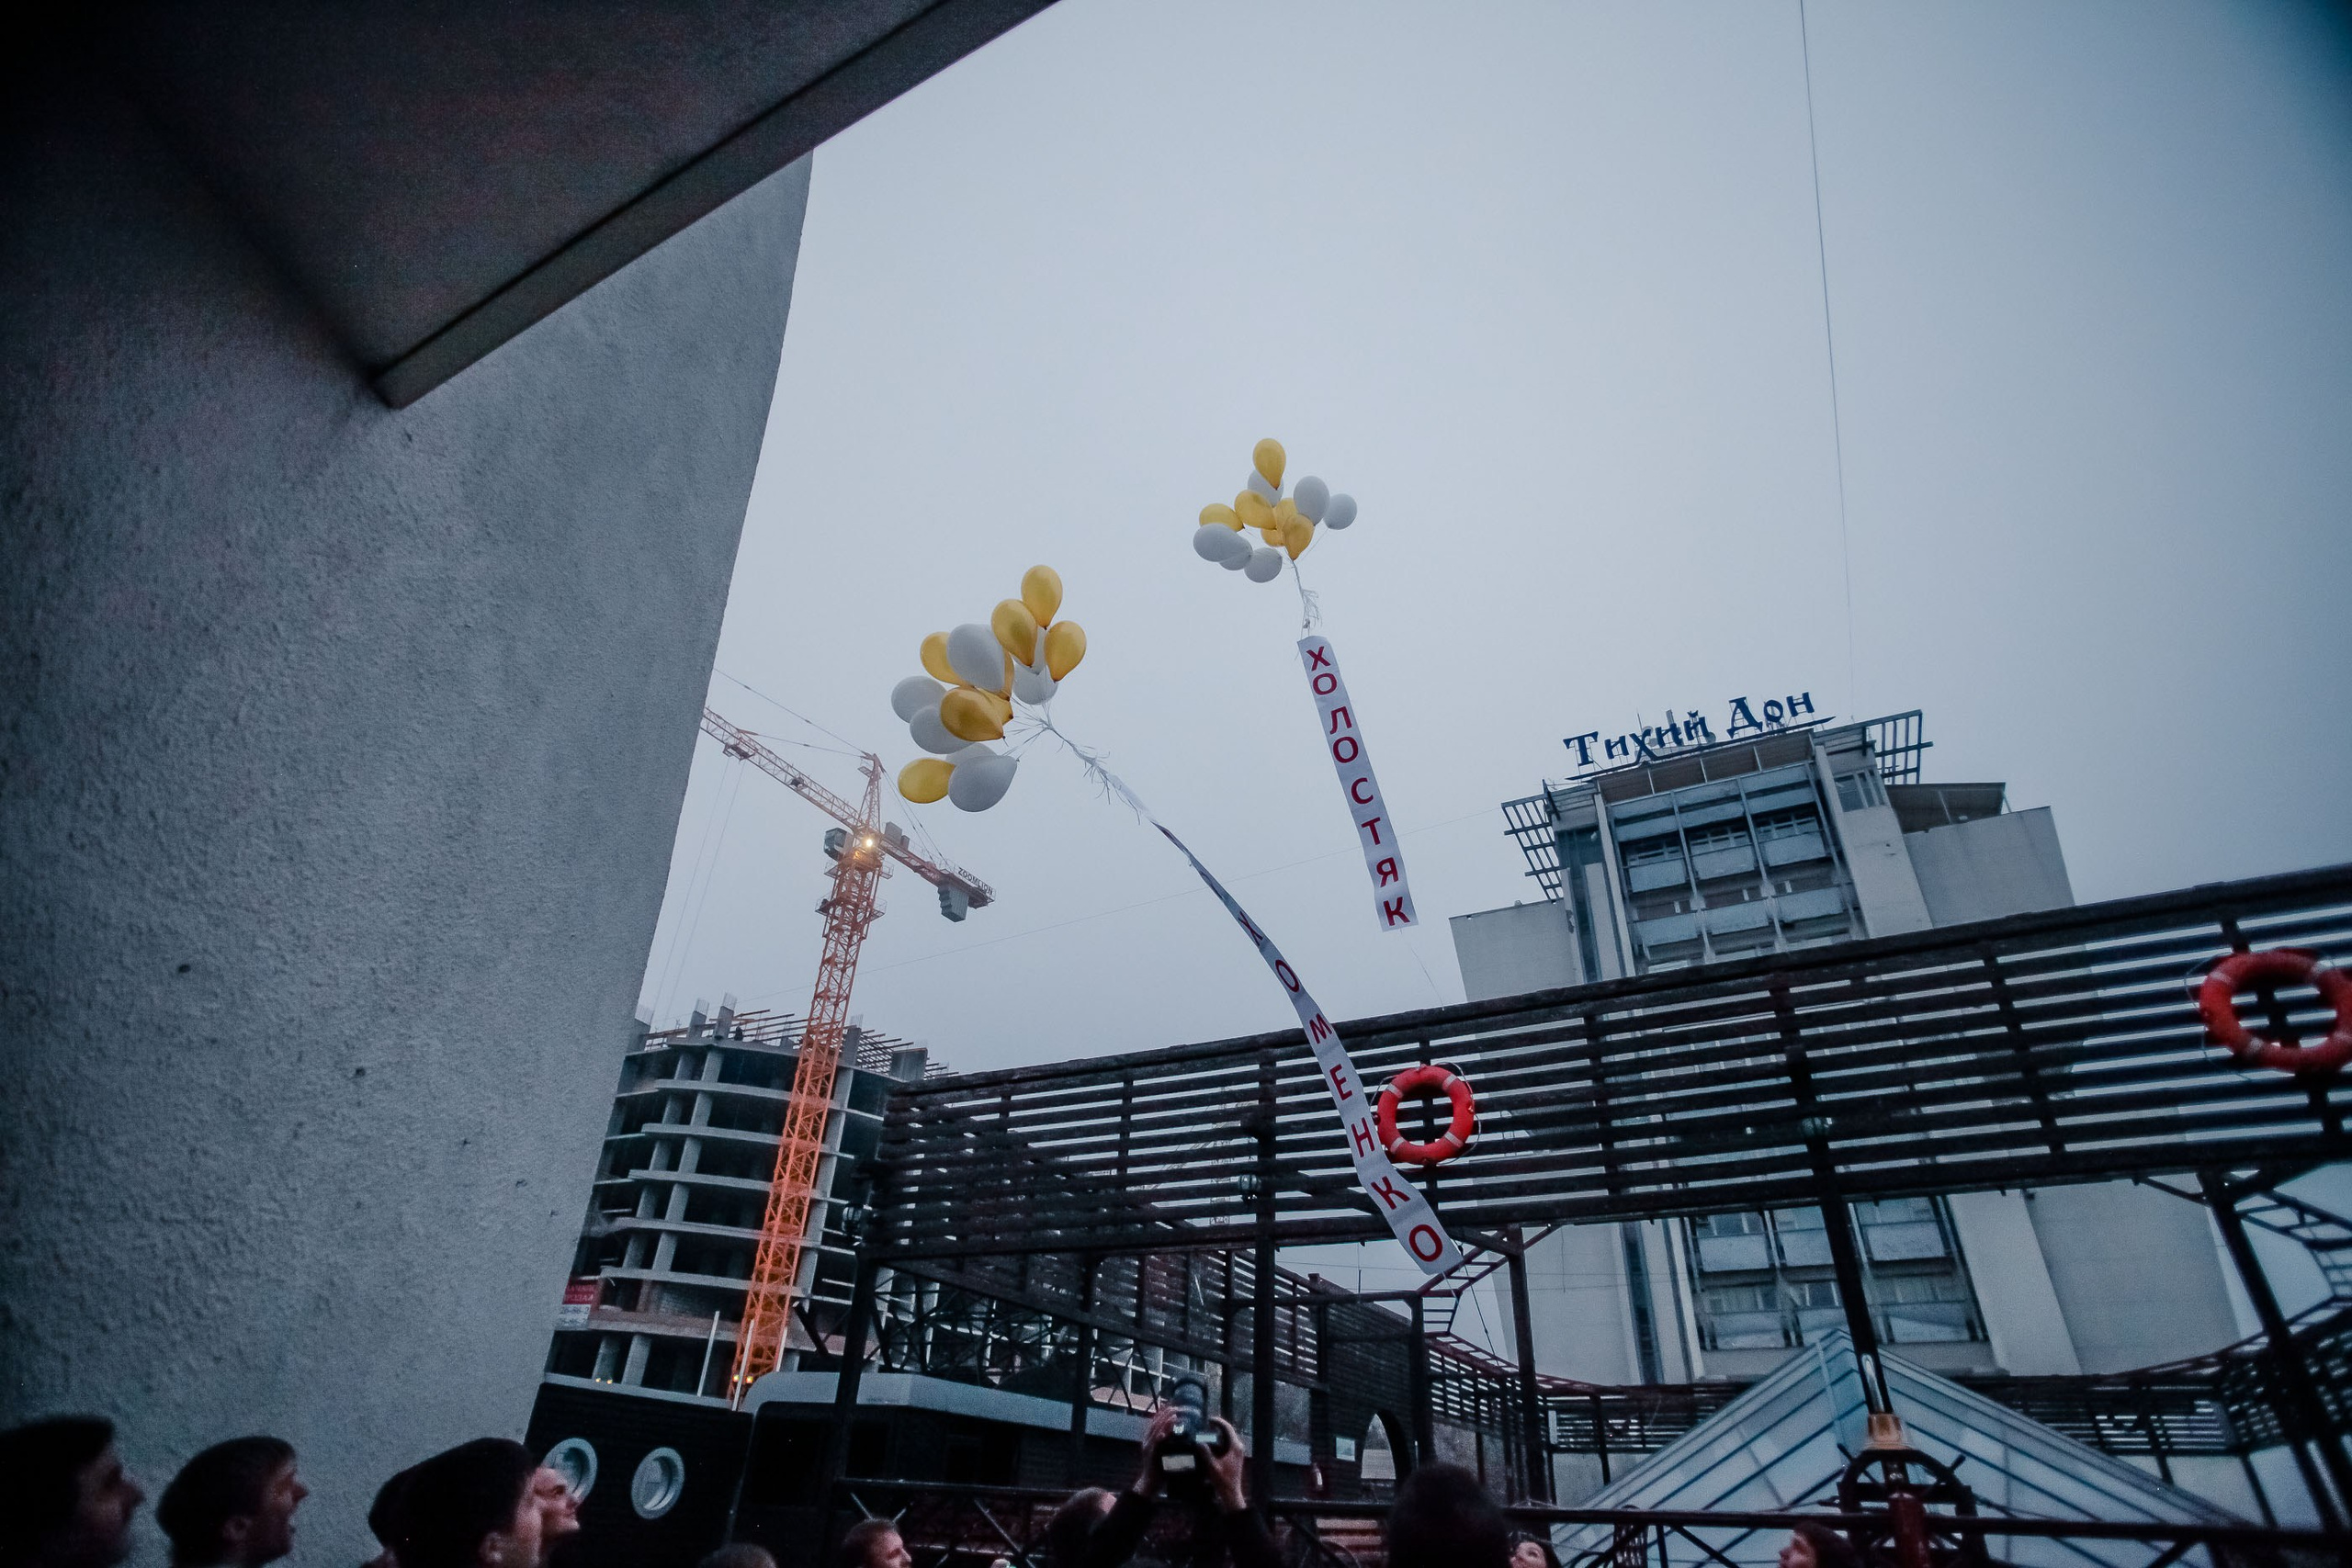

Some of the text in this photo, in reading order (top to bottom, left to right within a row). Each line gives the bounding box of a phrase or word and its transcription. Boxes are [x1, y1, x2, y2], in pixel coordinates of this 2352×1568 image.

[1306, 646, 1410, 926] ХОЛОСТЯК
[1563, 692, 1815, 765] Тихий Дон
[958, 866, 993, 896] ZOOMLION
[1161, 829, 1443, 1262] ХОМЕНКО
